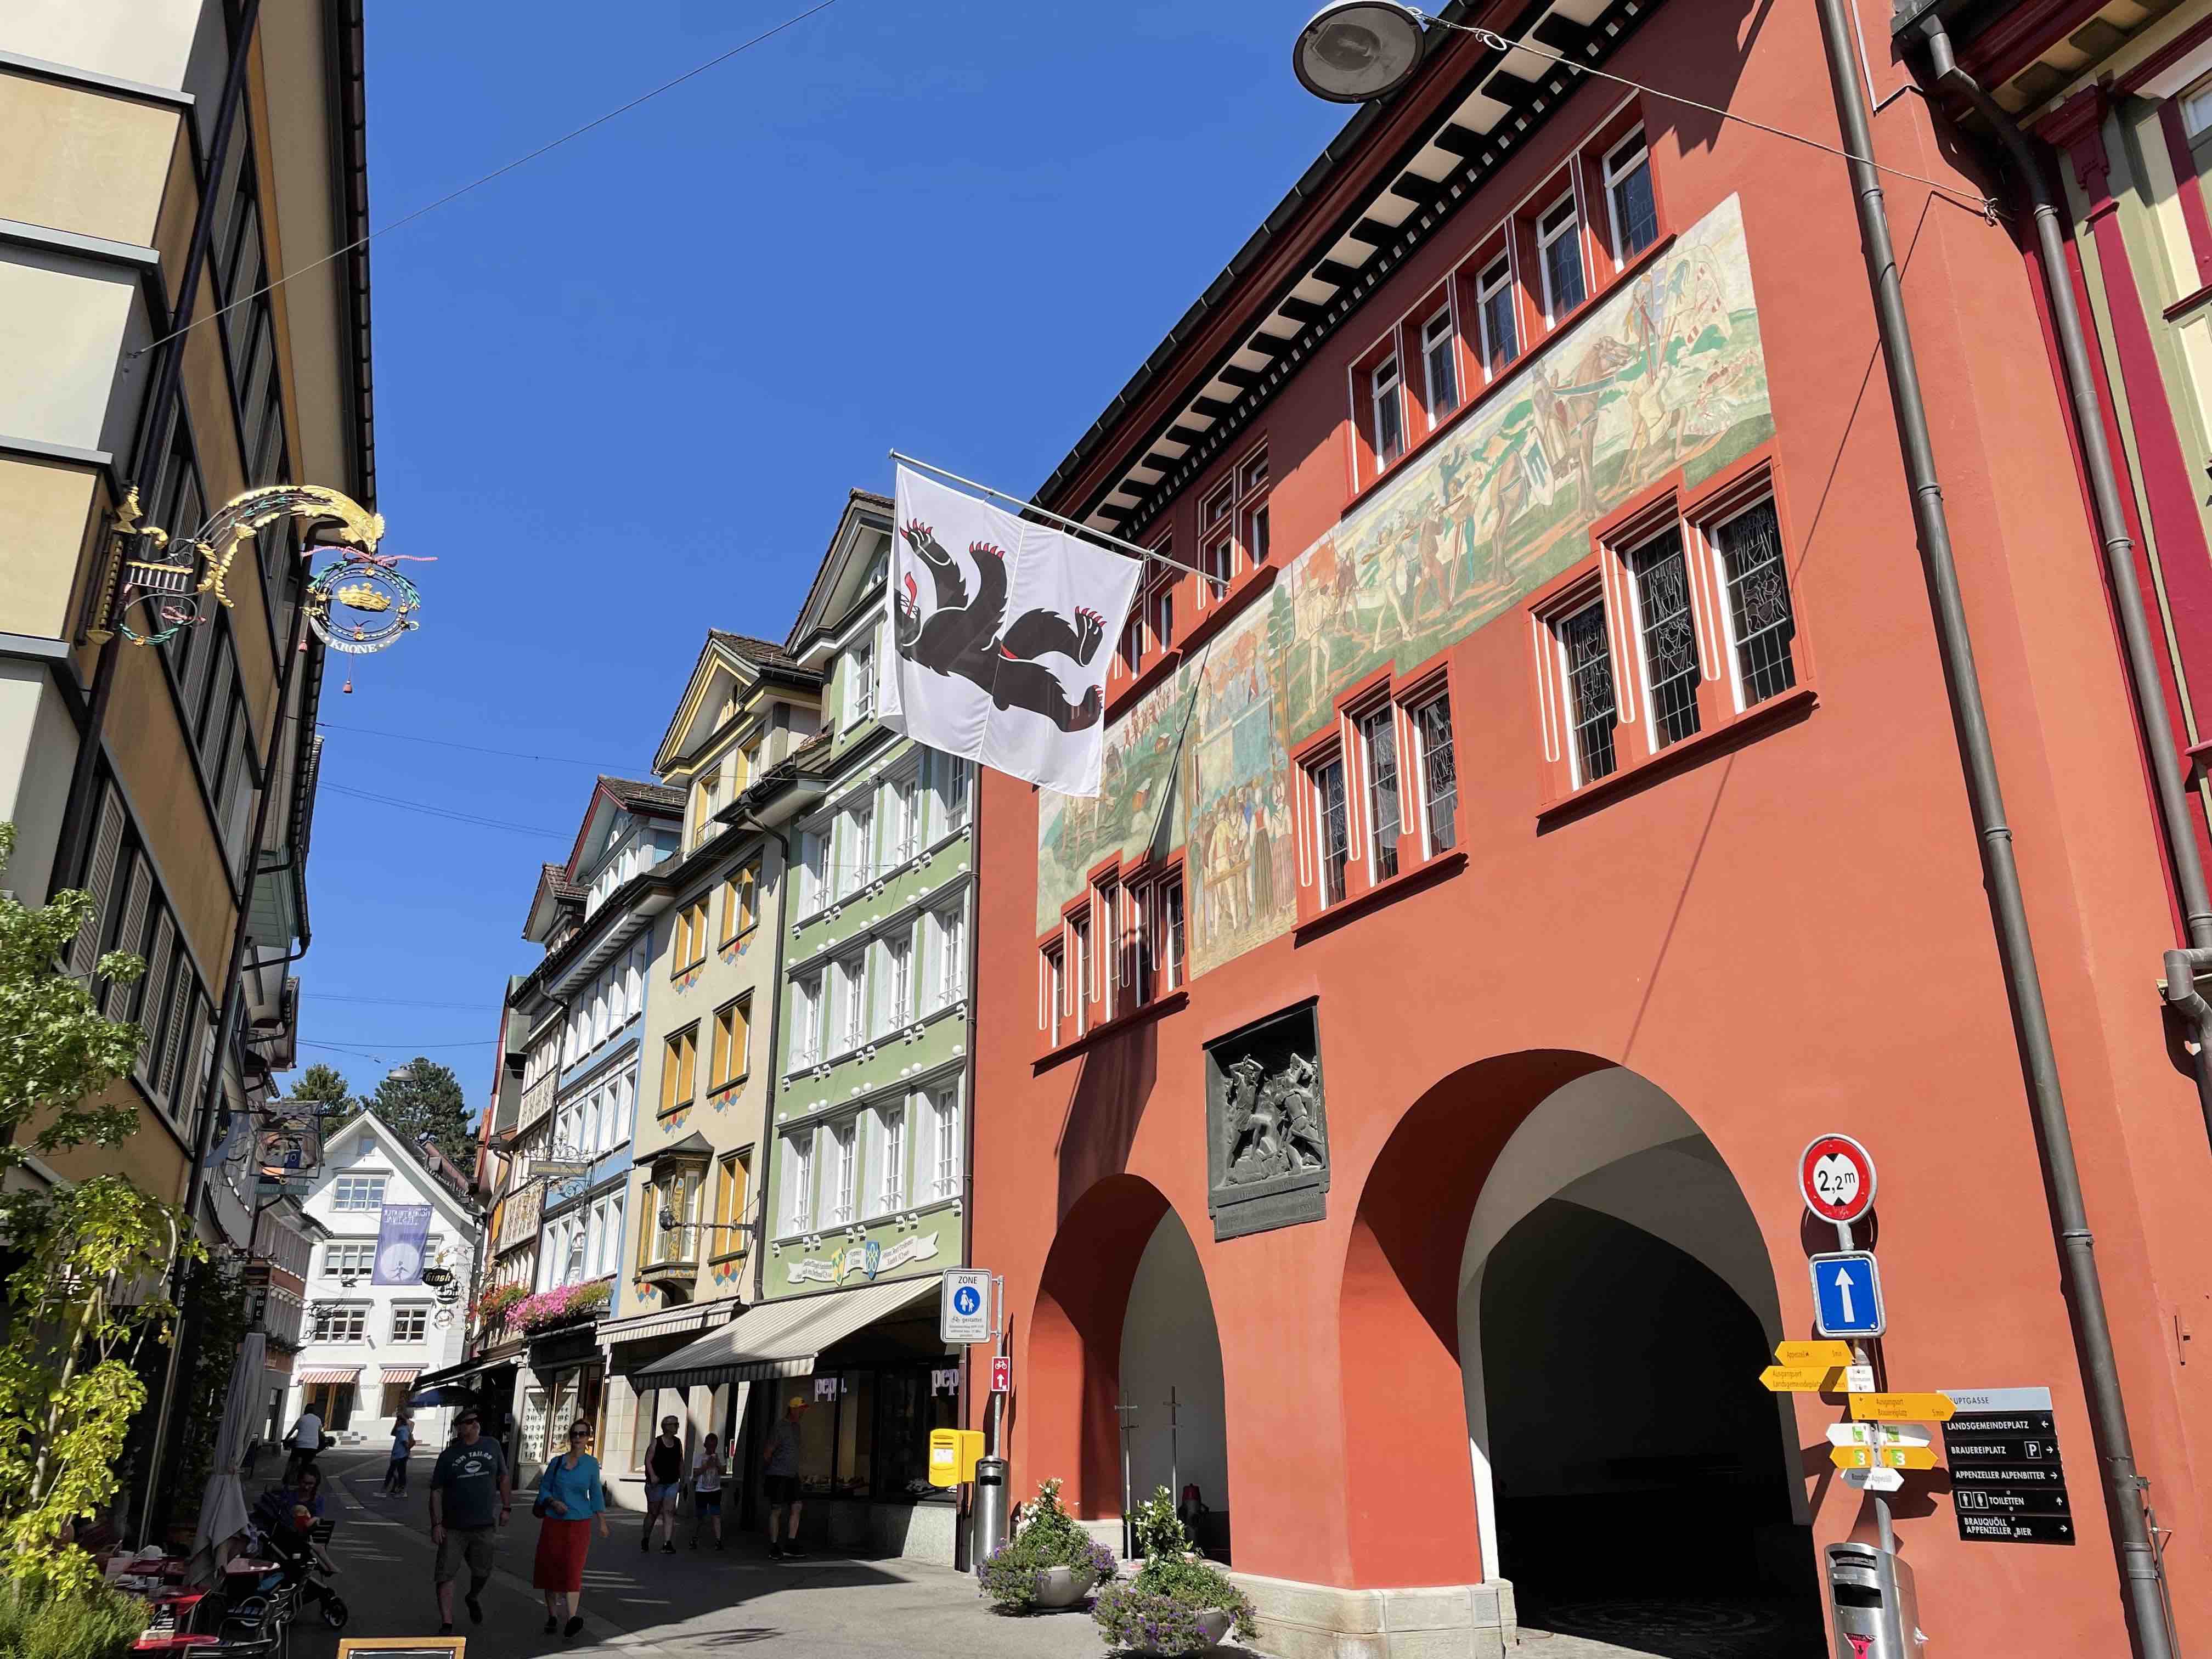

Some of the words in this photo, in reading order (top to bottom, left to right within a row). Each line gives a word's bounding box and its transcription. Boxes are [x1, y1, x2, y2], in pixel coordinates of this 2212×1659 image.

[329, 637, 378, 653] KRONE
[958, 1276, 978, 1284] ZONE
[930, 1369, 959, 1396] pep
[1948, 1421, 2029, 1430] LANDSGEMEINDEPLATZ
[1951, 1446, 2006, 1454] BRAUEREIPLATZ
[2029, 1443, 2038, 1457] P
[1955, 1471, 2000, 1479] APPENZELLER
[2001, 1471, 2046, 1480] ALPENBITTER
[1989, 1497, 2024, 1505] TOILETTEN
[1964, 1516, 2007, 1526] BRAUQUÖLL
[1966, 1526, 2012, 1535] APPENZELLER
[2016, 1527, 2032, 1536] BIER
